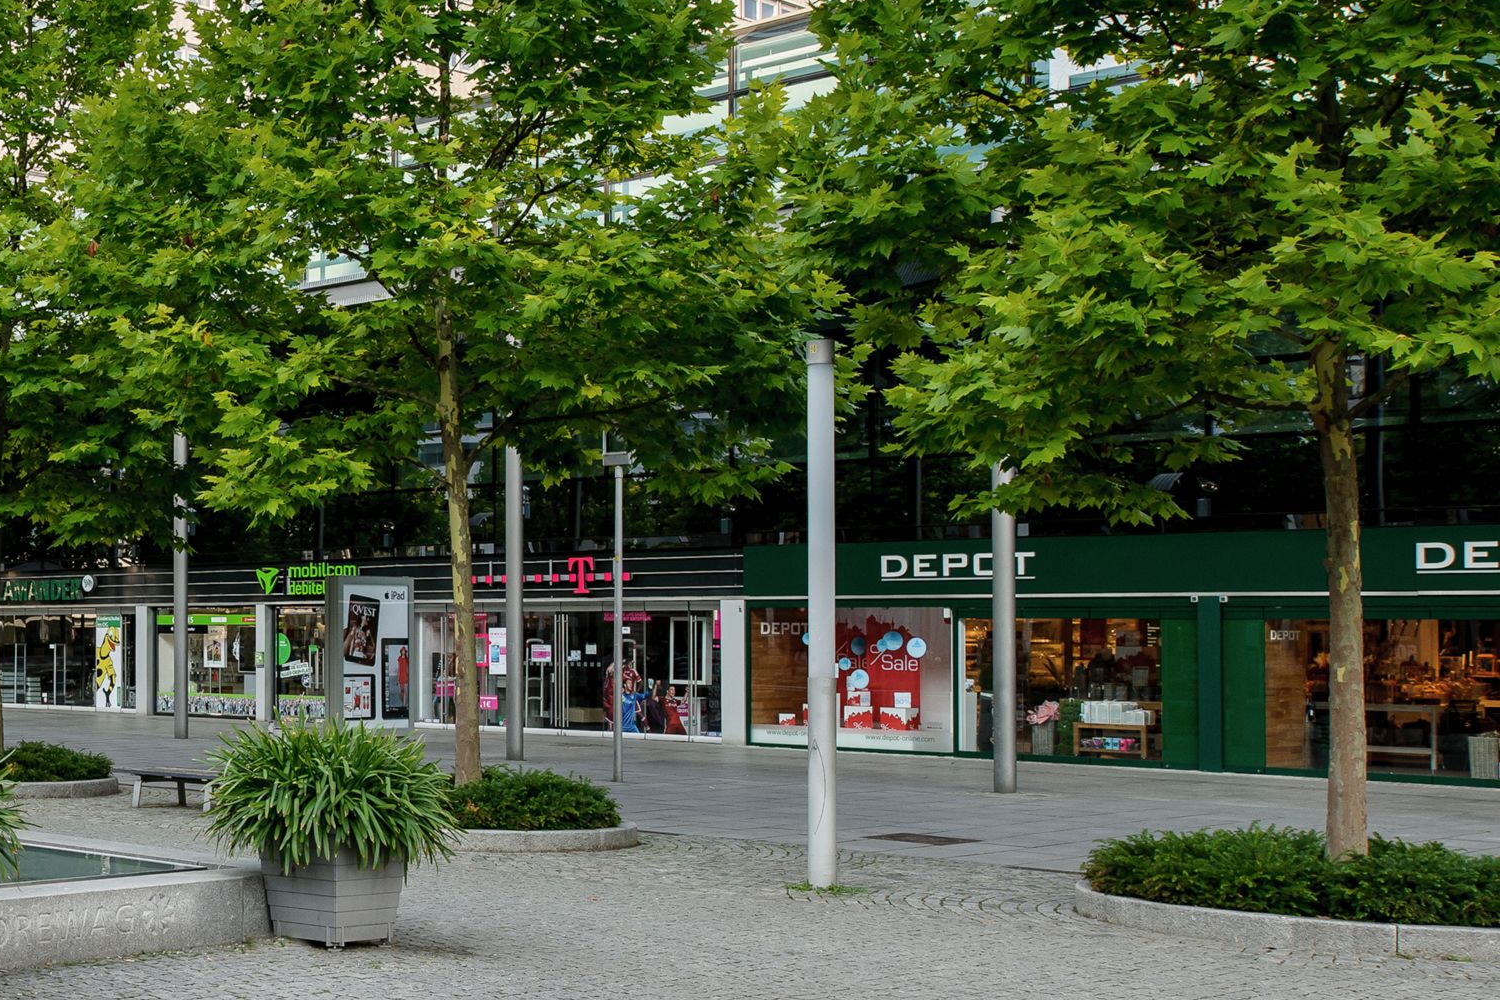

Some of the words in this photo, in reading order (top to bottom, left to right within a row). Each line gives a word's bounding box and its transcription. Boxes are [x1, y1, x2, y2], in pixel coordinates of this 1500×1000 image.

[288, 562, 357, 578] mobilcom
[881, 551, 1036, 578] DEPOT
[568, 556, 595, 594] T
[288, 580, 326, 595] debitel
[391, 590, 405, 600] iPad
[352, 604, 377, 617] QVEST
[760, 622, 809, 636] DEPOT
[1270, 630, 1299, 641] DEPOT
[881, 654, 919, 671] Sale
[865, 734, 936, 744] www.depot-online.com
